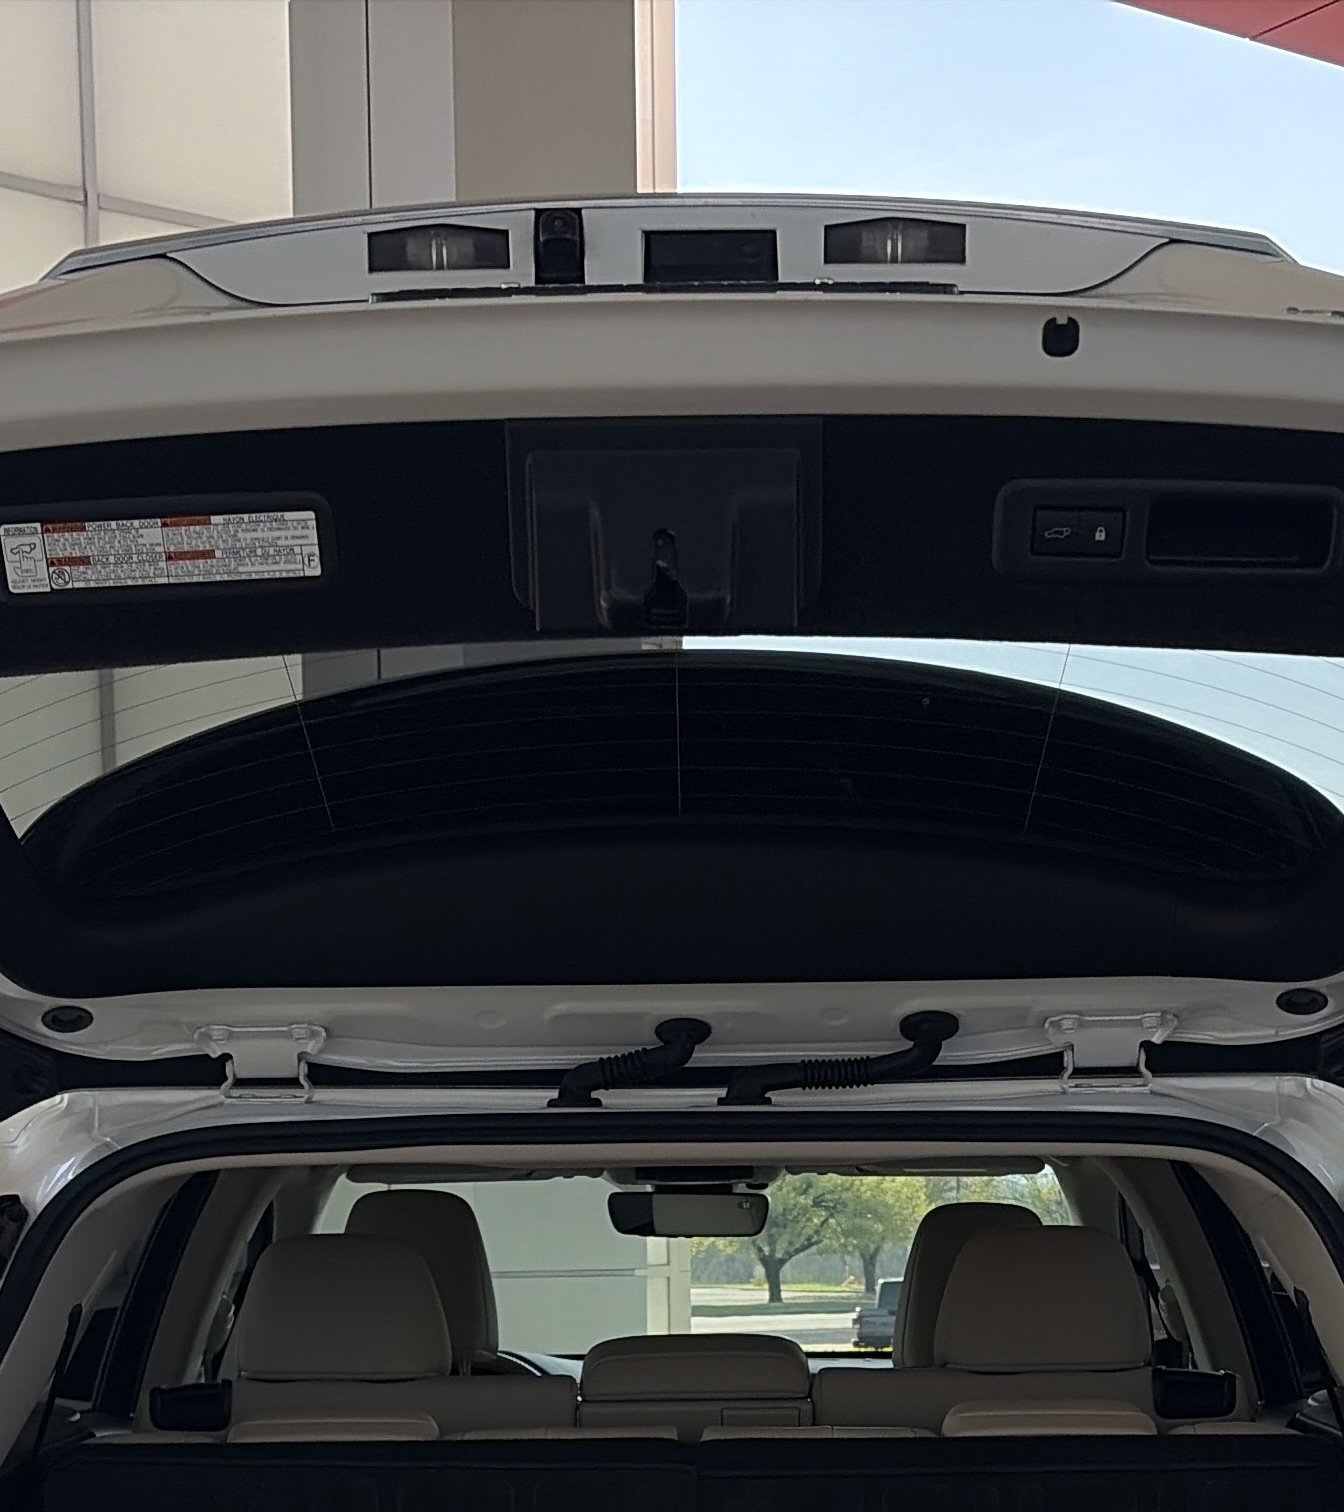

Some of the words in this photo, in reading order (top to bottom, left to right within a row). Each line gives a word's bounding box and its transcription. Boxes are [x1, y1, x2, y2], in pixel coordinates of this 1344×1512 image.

[87, 522, 112, 531] POWER
[116, 521, 135, 530] BACK
[138, 520, 159, 529] DOOR
[92, 556, 110, 565] BACK
[113, 554, 134, 563] DOOR
[137, 553, 163, 562] CLOSER
[307, 554, 316, 567] F
